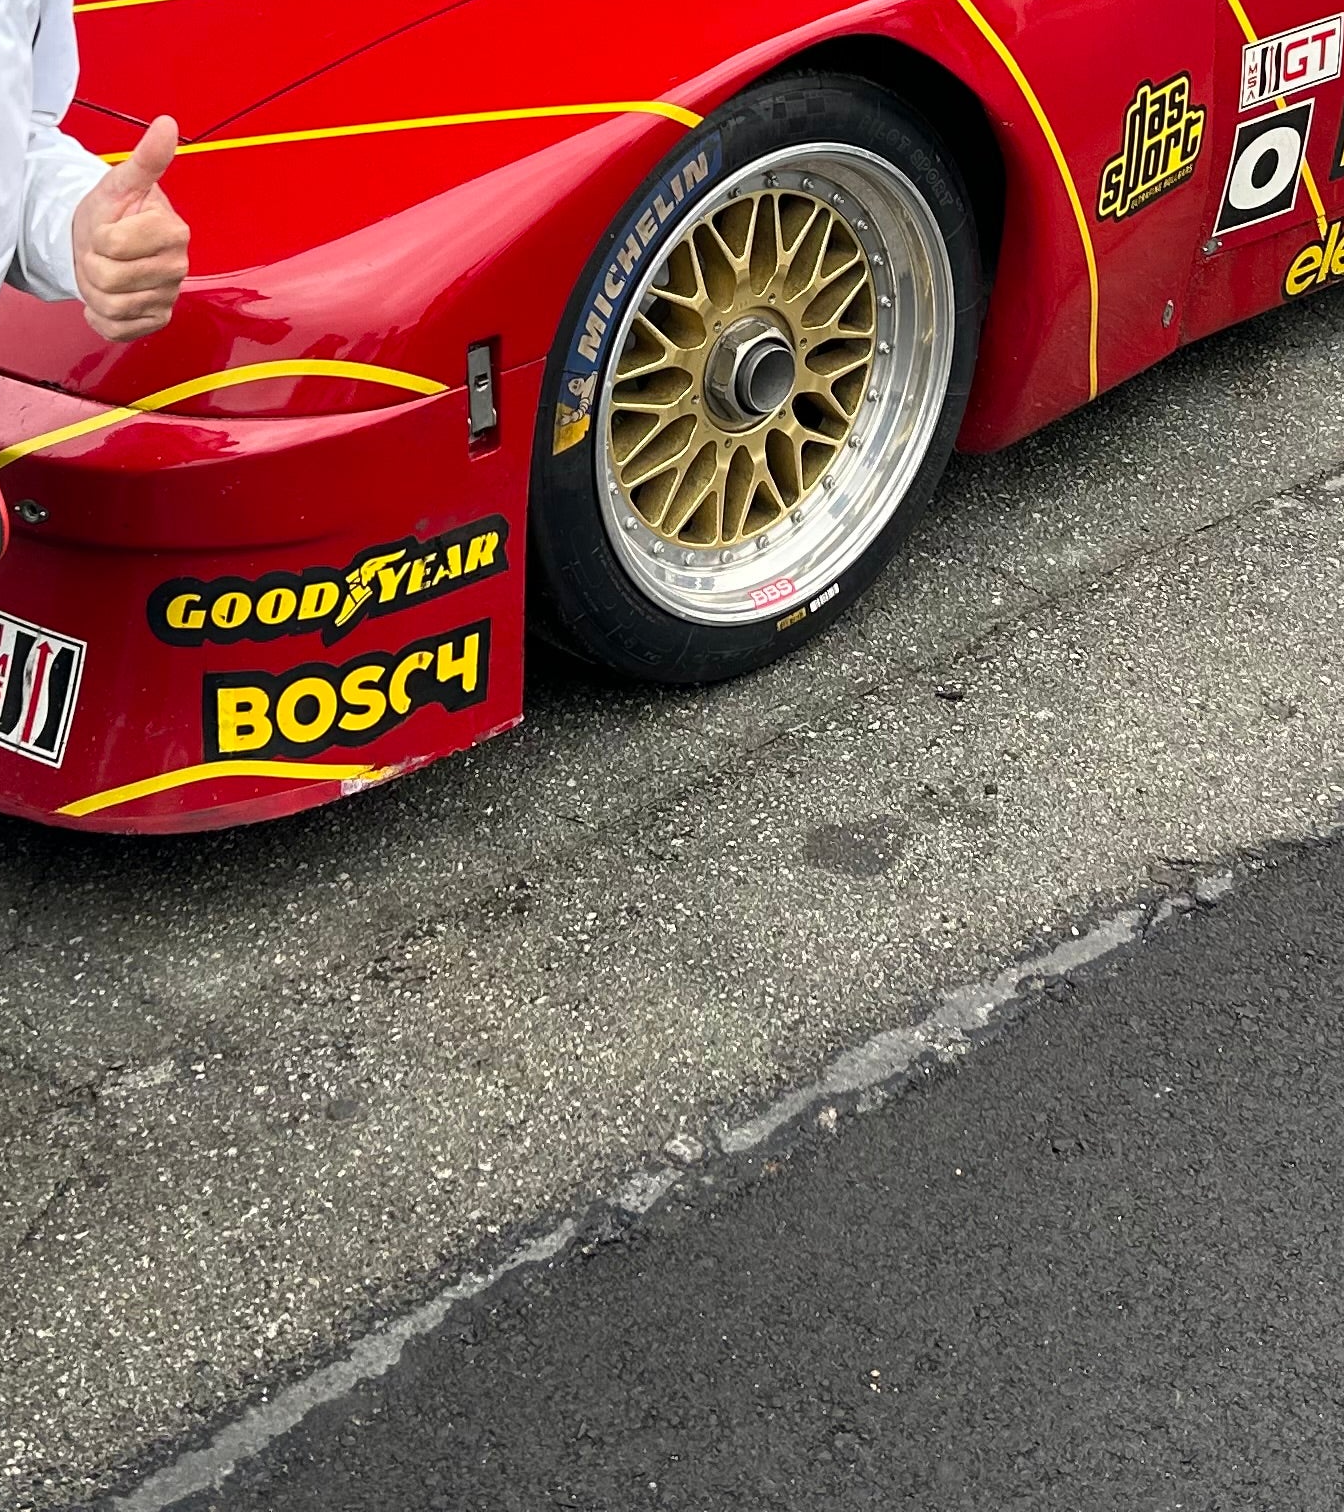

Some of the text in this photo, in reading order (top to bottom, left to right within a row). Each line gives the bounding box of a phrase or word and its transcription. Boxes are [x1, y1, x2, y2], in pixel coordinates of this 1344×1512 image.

[1283, 28, 1336, 83] GT
[577, 151, 709, 364] MICHELIN
[166, 530, 500, 630] GOODYEAR
[750, 581, 794, 606] BBS
